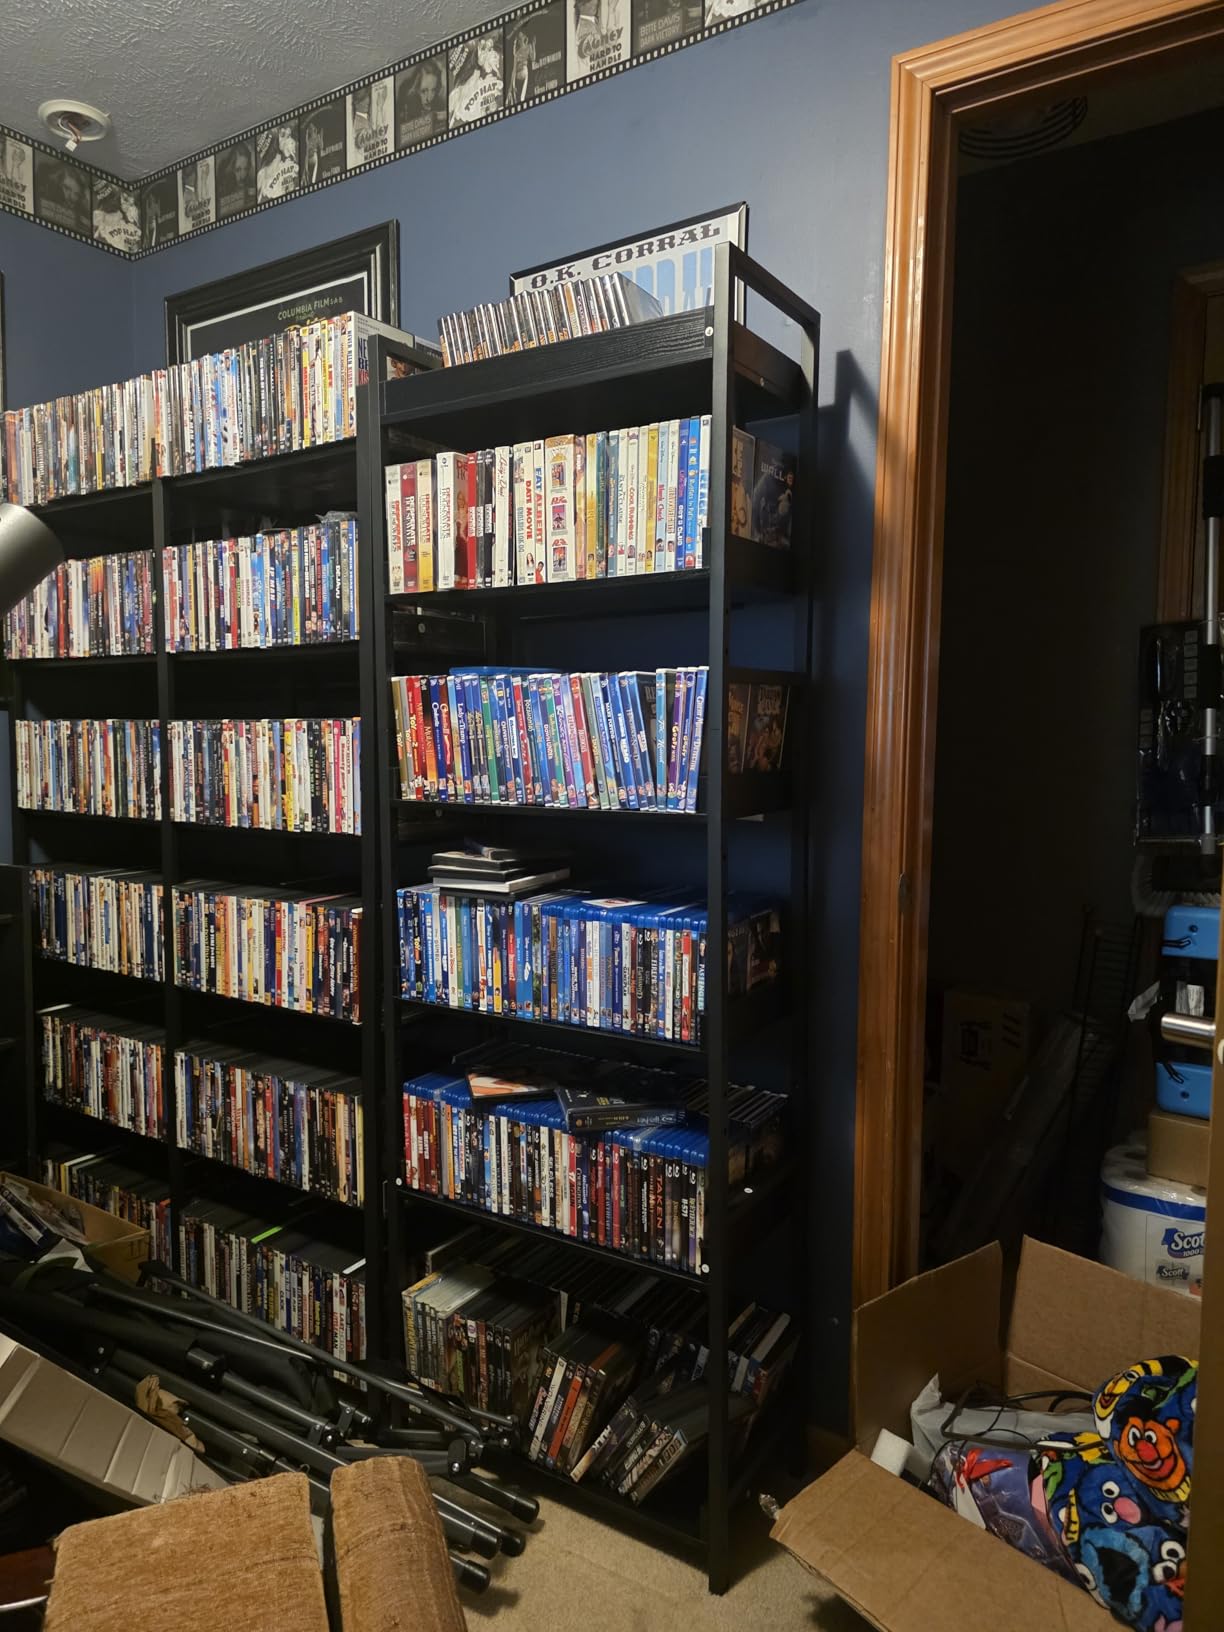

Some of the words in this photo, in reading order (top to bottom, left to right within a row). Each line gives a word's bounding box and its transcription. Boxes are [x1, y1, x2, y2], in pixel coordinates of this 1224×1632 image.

[640, 23, 658, 36] BETTE
[659, 15, 680, 29] DAVIS
[590, 48, 611, 63] HARD
[612, 43, 622, 52] TO
[590, 53, 622, 72] HANDLE
[464, 91, 480, 112] TOP
[481, 82, 498, 95] HAT
[363, 141, 380, 152] HARD
[381, 137, 388, 146] TO
[364, 146, 388, 161] HANDLE
[270, 173, 280, 189] TOP
[531, 264, 581, 289] O.K.
[592, 223, 720, 271] CORRAL
[278, 304, 312, 320] COLUMBIA
[314, 297, 330, 309] FILM
[535, 494, 543, 544] ALBERT
[524, 699, 534, 732] POCAHONTAS
[696, 696, 704, 717] GREAT
[424, 726, 432, 748] MULAN
[671, 726, 679, 749] GOOFY
[621, 738, 629, 763] NEMO
[569, 1172, 575, 1181] 17
[1161, 1268, 1184, 1277] Scott
[592, 1425, 612, 1451] HULK
